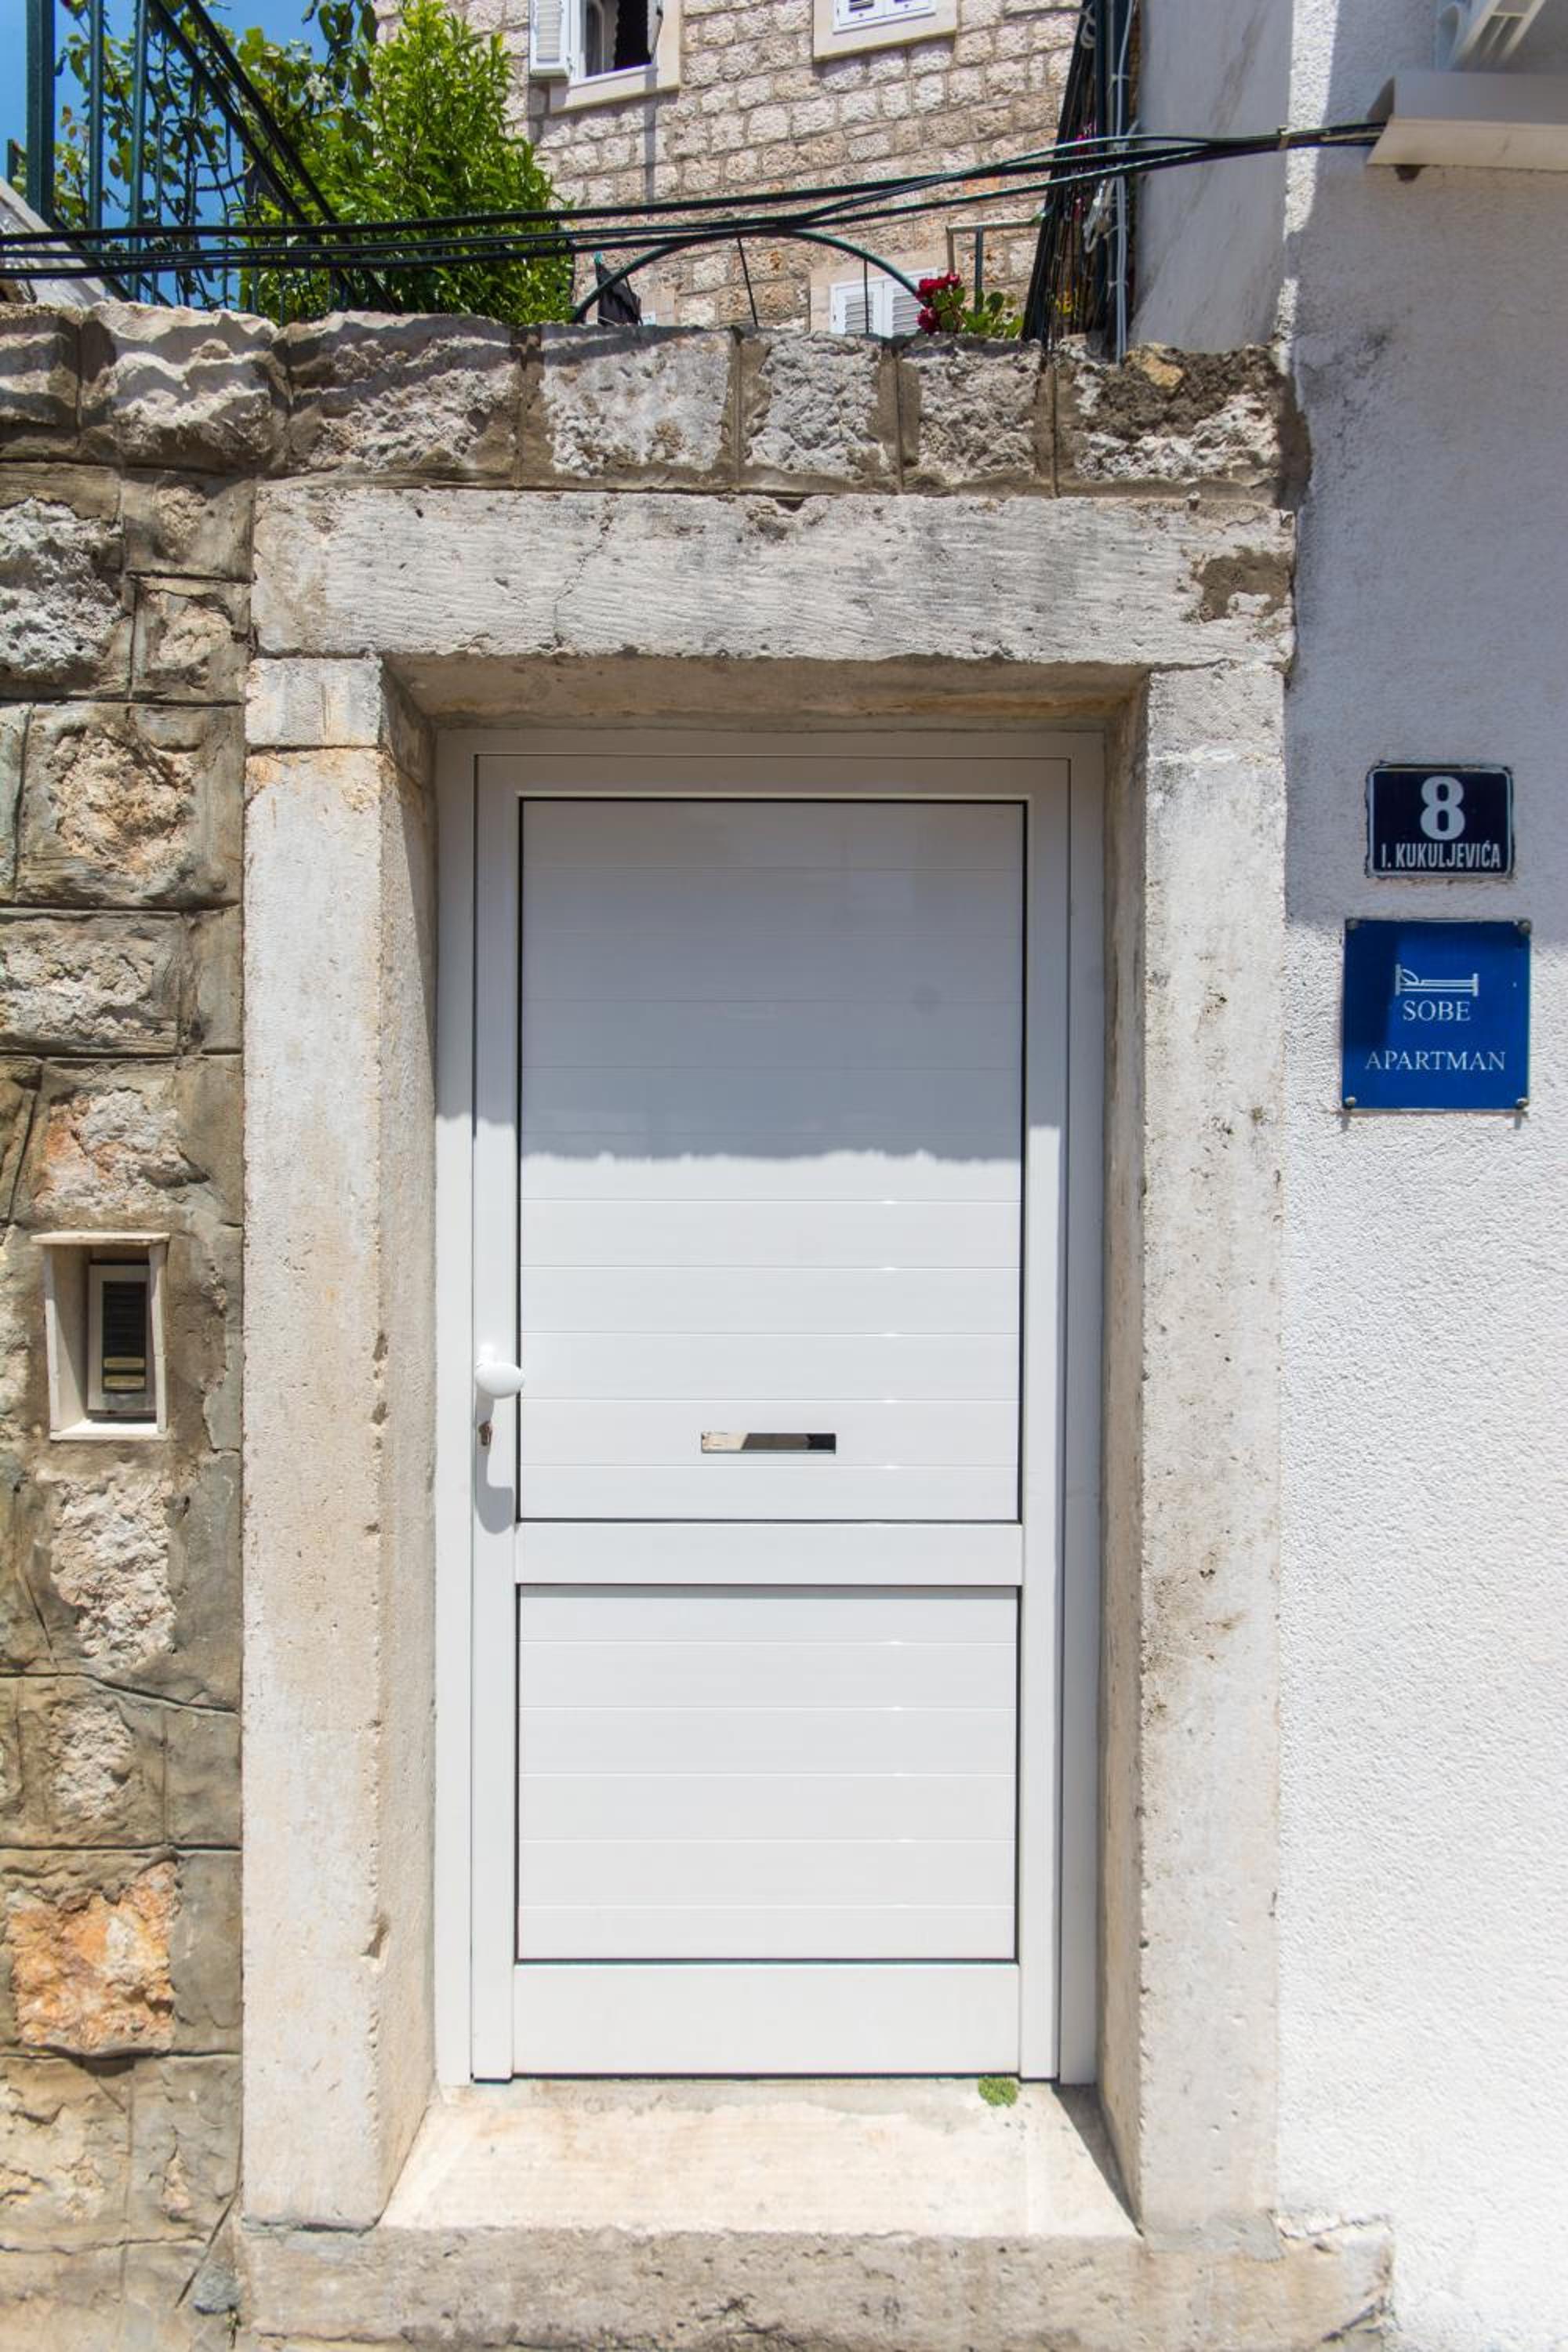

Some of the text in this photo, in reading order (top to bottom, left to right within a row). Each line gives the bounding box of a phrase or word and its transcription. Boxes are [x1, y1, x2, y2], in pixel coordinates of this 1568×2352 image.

[1420, 775, 1465, 840] 8
[1381, 840, 1501, 868] I. KUKULJEVIĆA
[1403, 1000, 1471, 1022] SOBE
[1365, 1051, 1506, 1070] APARTMAN
